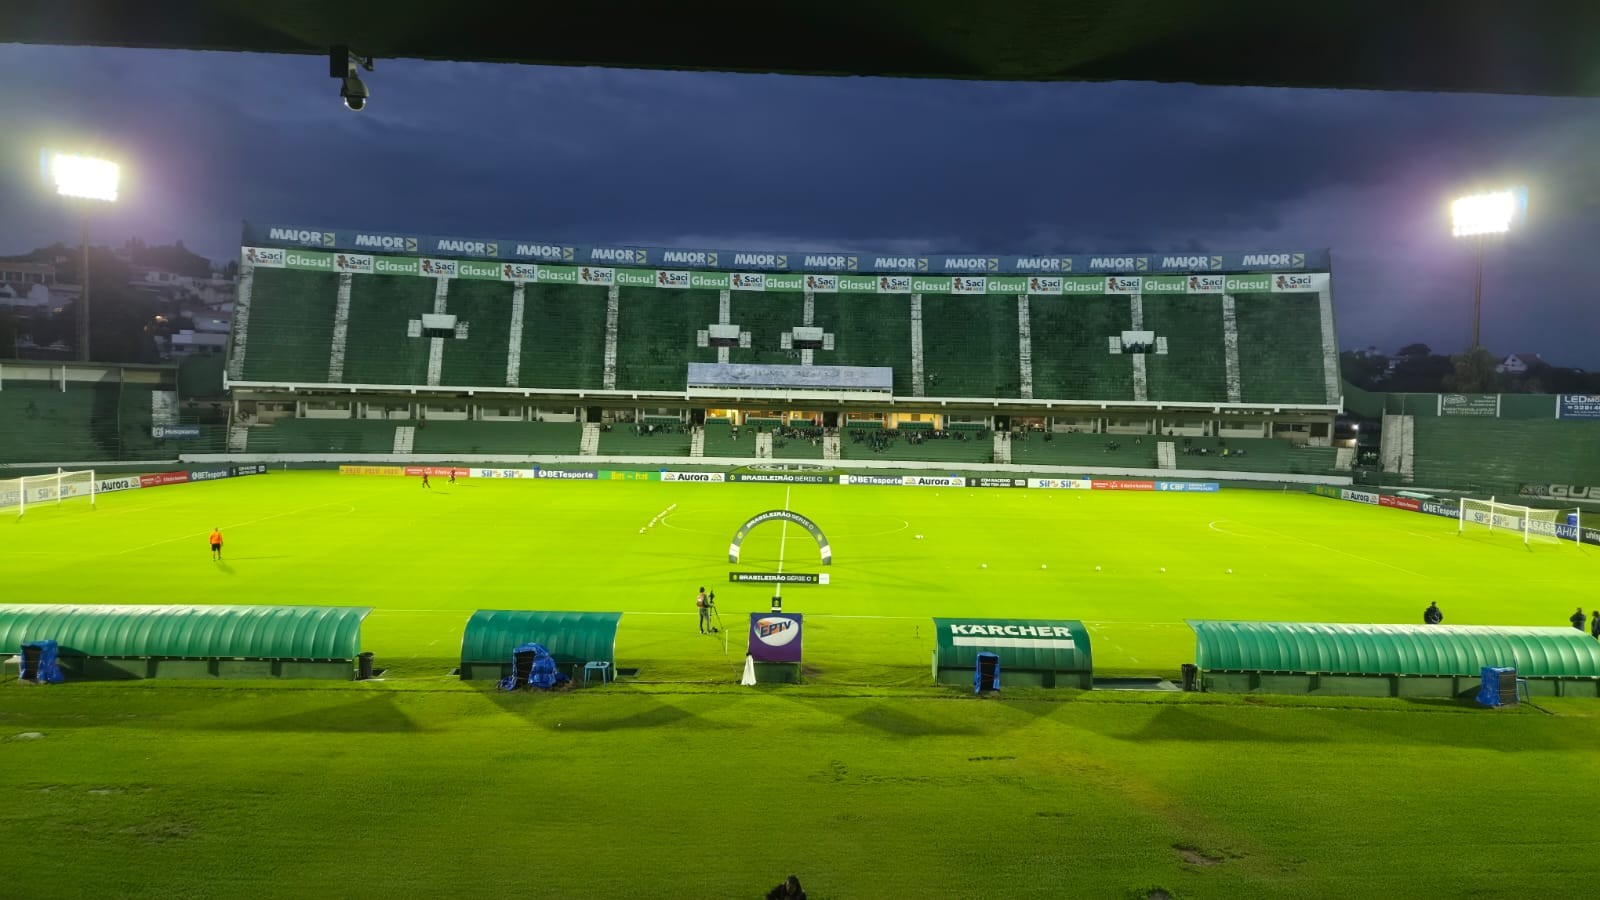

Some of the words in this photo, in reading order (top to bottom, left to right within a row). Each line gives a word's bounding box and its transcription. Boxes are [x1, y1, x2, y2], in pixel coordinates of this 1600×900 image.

[270, 228, 321, 242] MAIOR
[356, 235, 404, 248] MAIOR
[438, 239, 485, 252] MAIOR
[260, 251, 282, 260] Saci
[516, 244, 561, 257] MAIOR
[591, 248, 635, 260] MAIOR
[286, 255, 331, 267] Glasu!
[351, 257, 371, 266] Saci
[664, 251, 705, 263] MAIOR
[734, 254, 775, 265] MAIOR
[804, 256, 845, 267] MAIOR
[1090, 257, 1134, 268] MAIOR
[1162, 256, 1208, 268] MAIOR
[1242, 254, 1290, 265] MAIOR
[375, 260, 417, 272] Glasu!
[435, 261, 455, 270] Saci
[874, 258, 916, 269] MAIOR
[945, 258, 986, 269] MAIOR
[1016, 258, 1059, 269] MAIOR
[460, 265, 499, 277] Glasu!
[516, 266, 535, 274] Saci
[537, 269, 576, 281] Glasu!
[593, 270, 612, 278] Saci
[617, 272, 654, 284] Glasu!
[670, 273, 688, 281] Saci
[692, 276, 729, 287] Glasu!
[744, 275, 762, 283] Saci
[818, 277, 836, 285] Saci
[891, 278, 909, 286] Saci
[1202, 277, 1223, 285] Saci
[1290, 276, 1311, 284] Saci
[766, 279, 802, 289] Glasu!
[839, 280, 875, 290] Glasu!
[914, 281, 950, 291] Glasu!
[966, 279, 984, 287] Saci
[988, 281, 1025, 292] Glasu!
[1041, 279, 1060, 287] Saci
[1064, 281, 1103, 292] Glasu!
[1120, 279, 1140, 287] Saci
[1145, 280, 1185, 291] Glasu!
[1226, 279, 1269, 290] Glasu!
[547, 470, 593, 479] BETesporte
[678, 473, 708, 481] Aurora
[101, 480, 128, 491] Aurora
[1040, 480, 1050, 488] Sil
[1061, 480, 1071, 488] Sil
[1350, 492, 1370, 502] Aurora
[746, 511, 791, 529] BRASILEIRÃO
[760, 620, 791, 638] EPTV
[950, 624, 1072, 637] KÄRCHER
